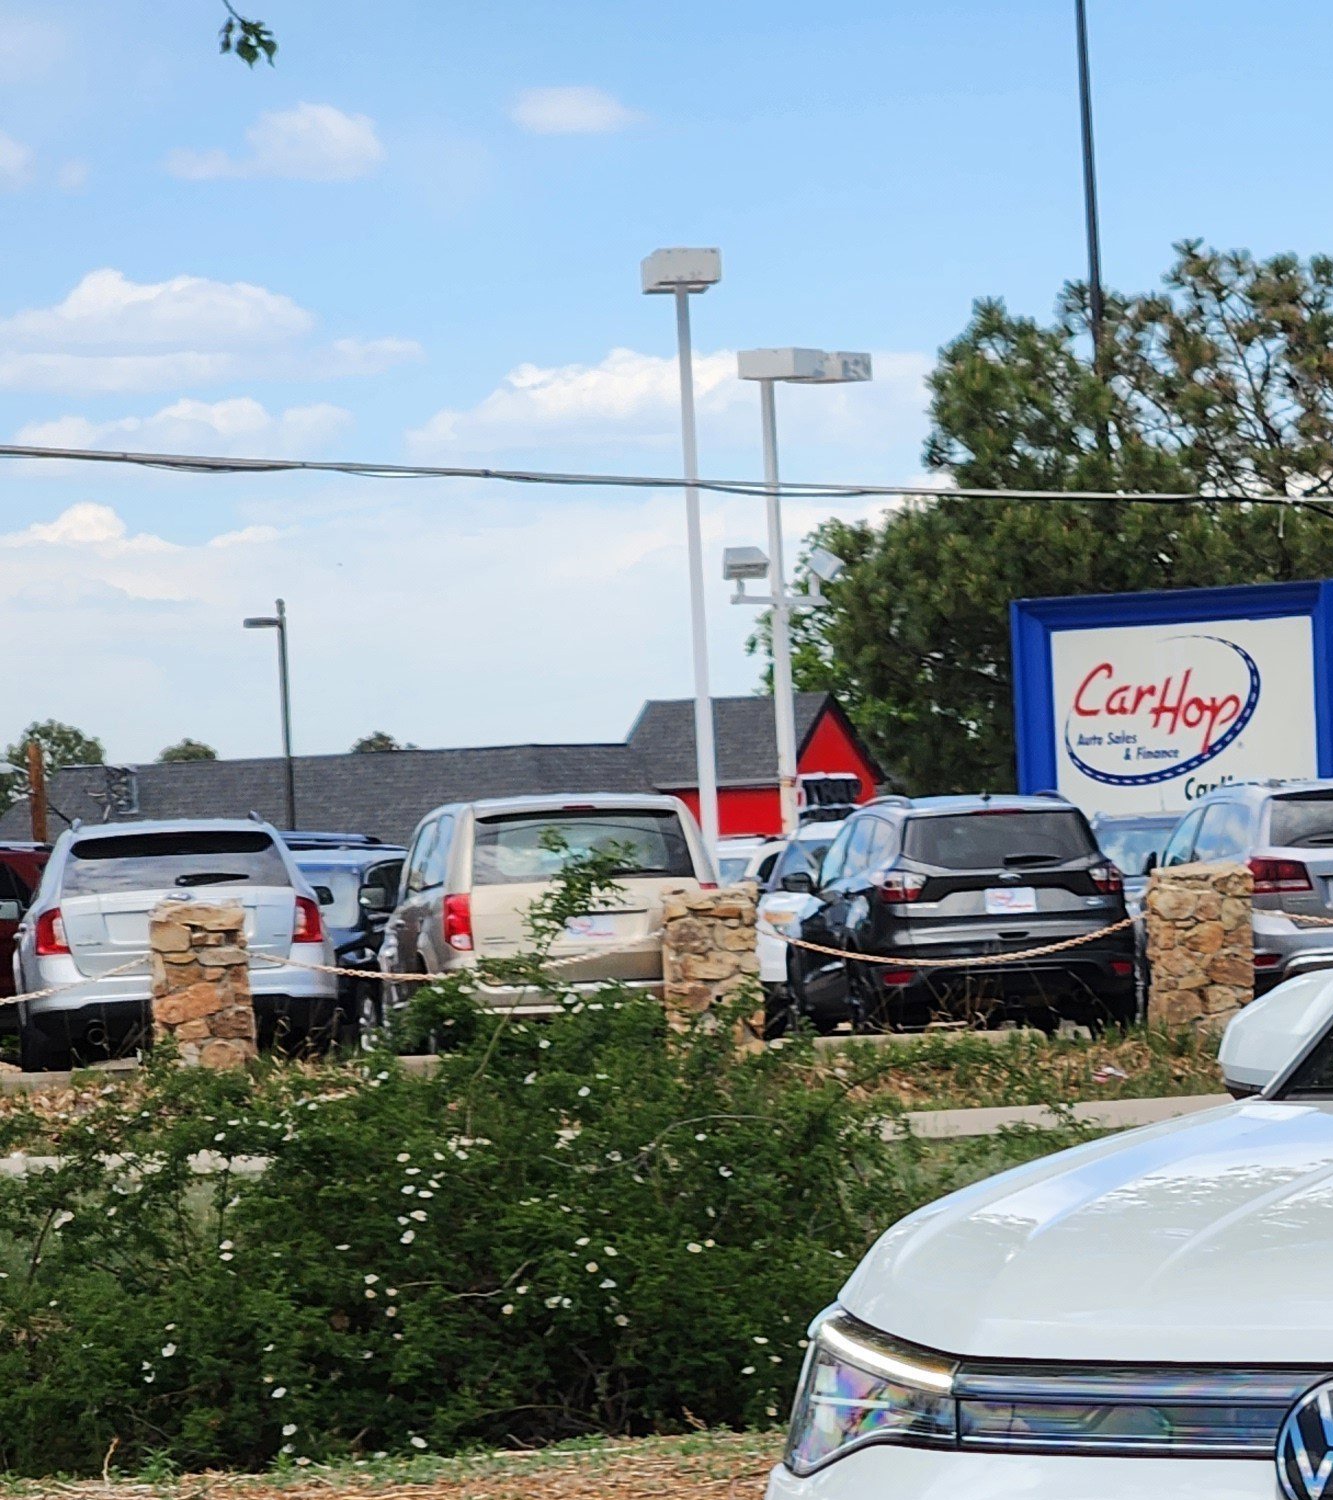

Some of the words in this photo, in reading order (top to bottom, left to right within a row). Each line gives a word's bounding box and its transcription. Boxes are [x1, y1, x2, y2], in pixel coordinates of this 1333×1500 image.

[1074, 662, 1241, 754] CarHop
[1077, 733, 1103, 746] Auto
[1107, 730, 1138, 746] Sales
[1123, 747, 1132, 761] &
[1136, 746, 1180, 760] Finance
